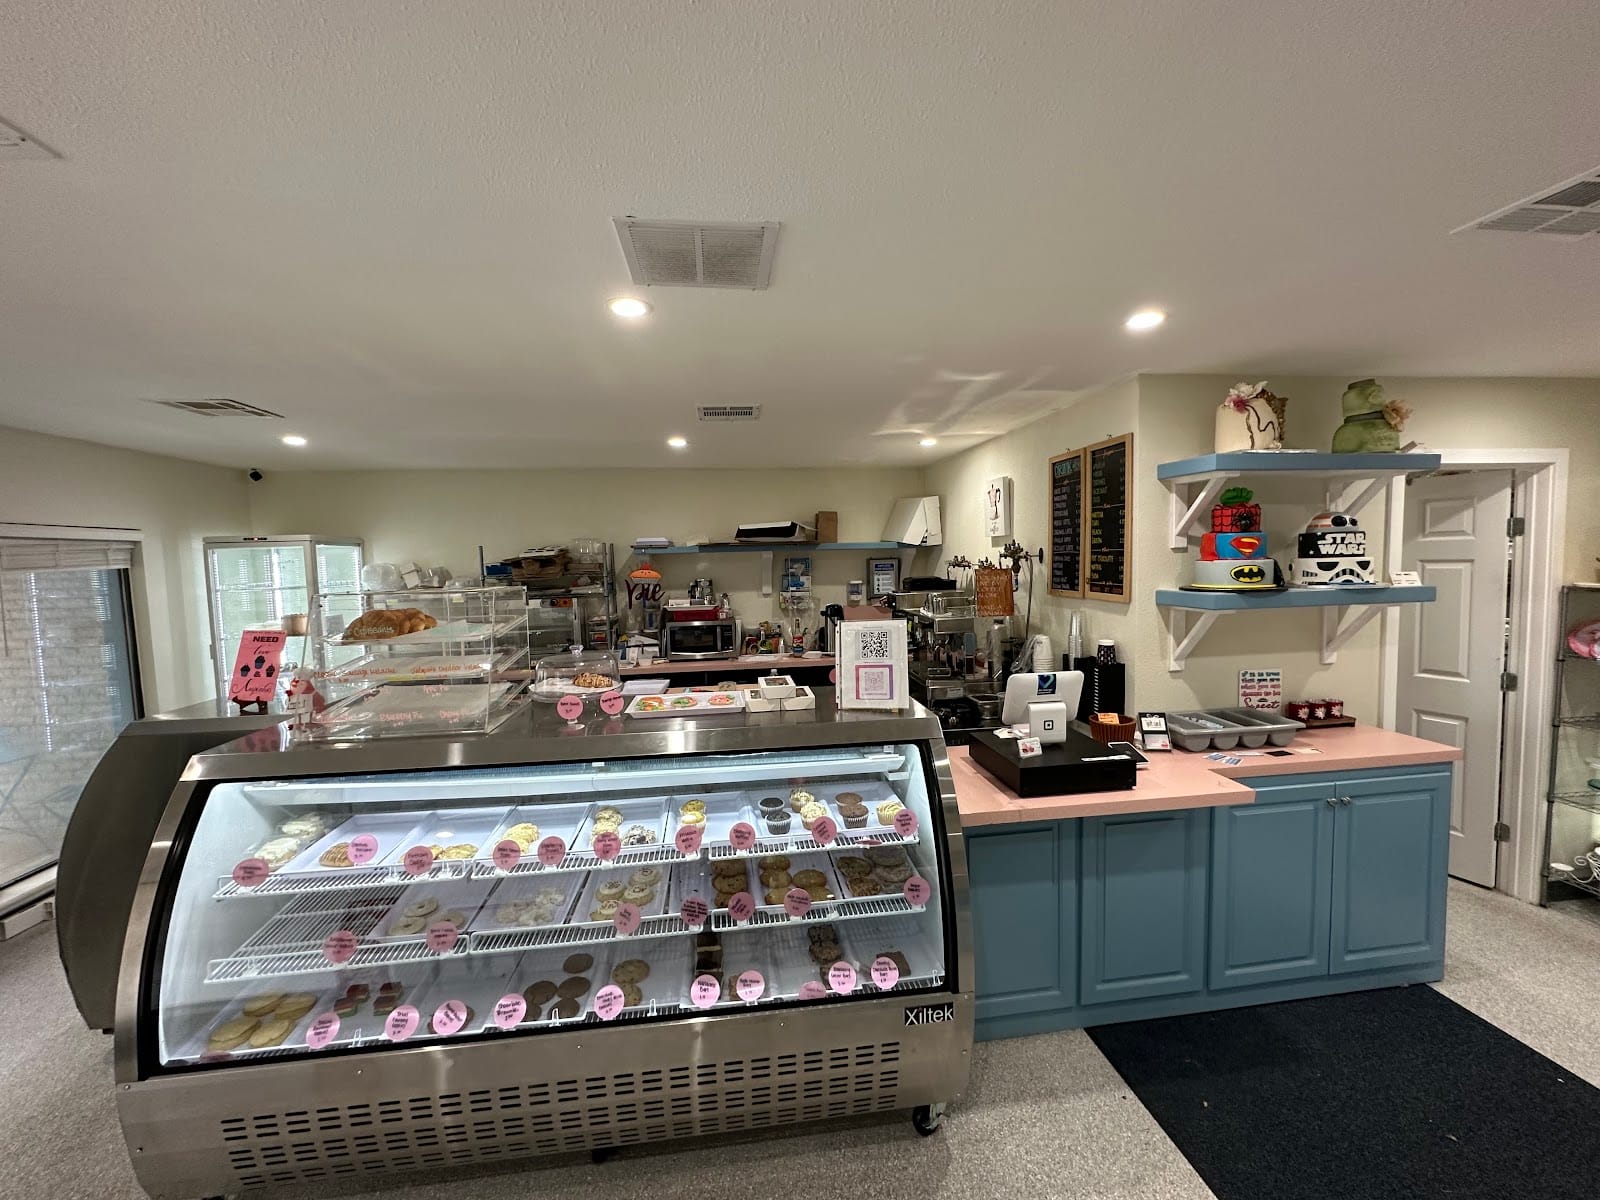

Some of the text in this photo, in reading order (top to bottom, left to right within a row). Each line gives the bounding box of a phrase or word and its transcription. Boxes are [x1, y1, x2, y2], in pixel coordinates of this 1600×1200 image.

[1317, 532, 1366, 544] STAR
[1318, 543, 1366, 555] WARS
[252, 635, 279, 643] NEED
[1244, 697, 1280, 709] Sweet
[905, 1004, 954, 1026] Xiltek
